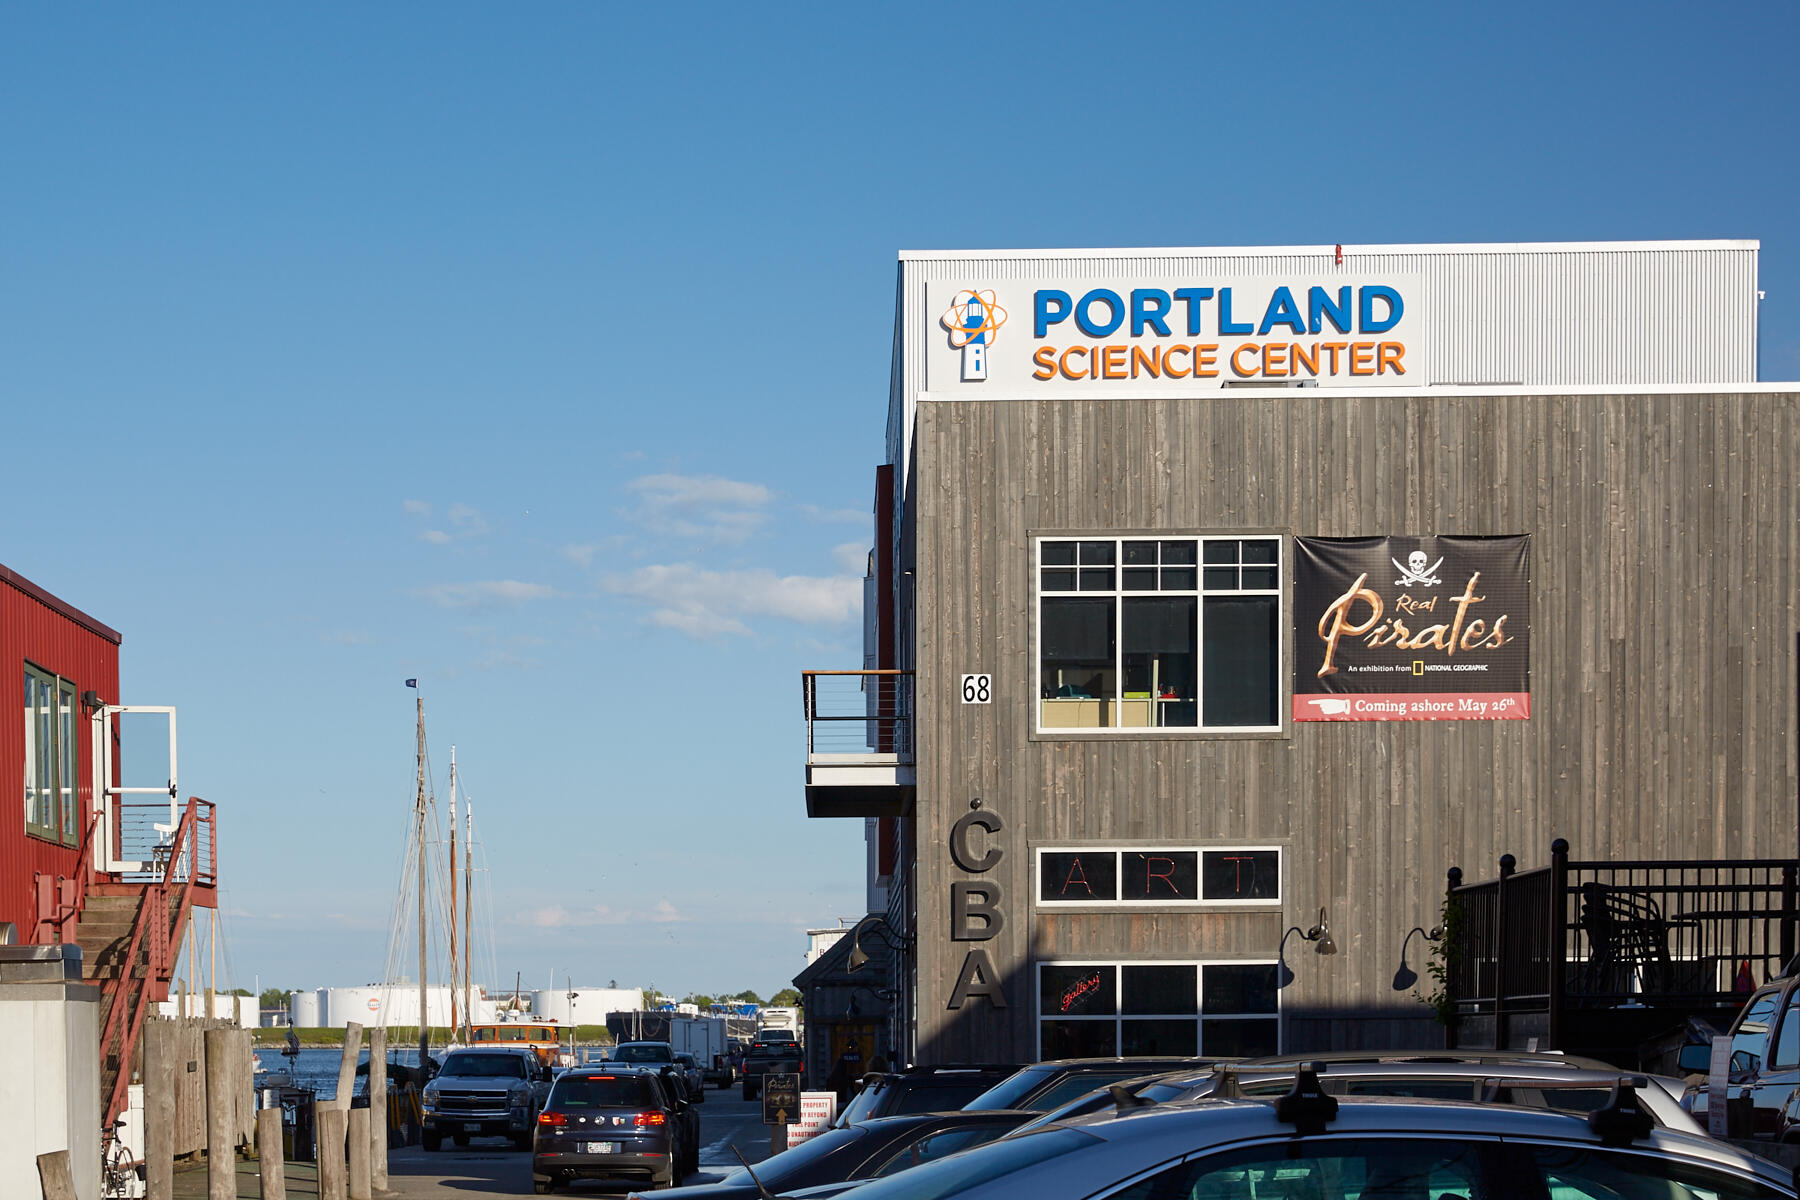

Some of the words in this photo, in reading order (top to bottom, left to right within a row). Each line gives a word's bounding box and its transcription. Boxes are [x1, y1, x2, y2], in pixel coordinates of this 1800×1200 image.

[1034, 285, 1405, 338] PORTLAND
[1033, 345, 1219, 380] SCIENCE
[1231, 342, 1407, 377] CENTER
[1395, 593, 1438, 615] Real
[1317, 572, 1514, 678] Pirates
[1359, 664, 1394, 672] exhibition
[1395, 664, 1412, 672] from
[1425, 664, 1452, 672] NATIONAL
[1453, 664, 1488, 672] GEOGRAPHIC
[963, 676, 990, 702] 68
[1355, 699, 1407, 715] Coming
[1411, 699, 1454, 712] ashore
[1458, 698, 1488, 715] May
[1492, 697, 1515, 711] 26th
